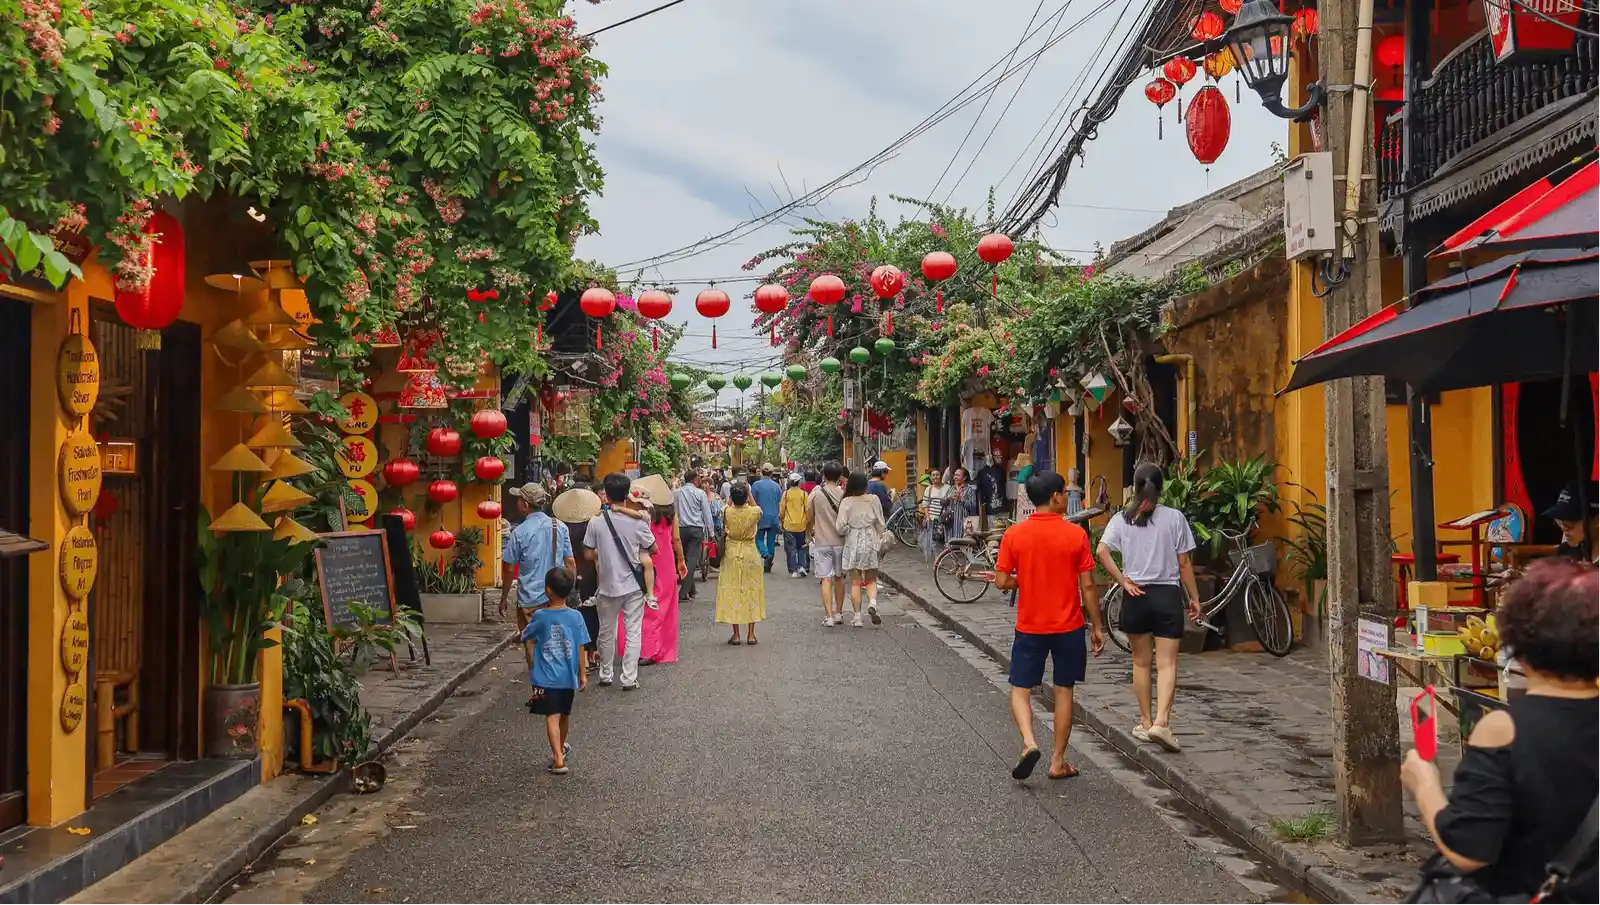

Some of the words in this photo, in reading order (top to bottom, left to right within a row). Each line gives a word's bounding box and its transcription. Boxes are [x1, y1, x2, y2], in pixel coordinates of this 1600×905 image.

[73, 390, 90, 403] Silver
[68, 465, 99, 482] Freshwater
[77, 488, 92, 502] Pearl
[73, 555, 93, 573] Filigree
[77, 577, 86, 590] Art
